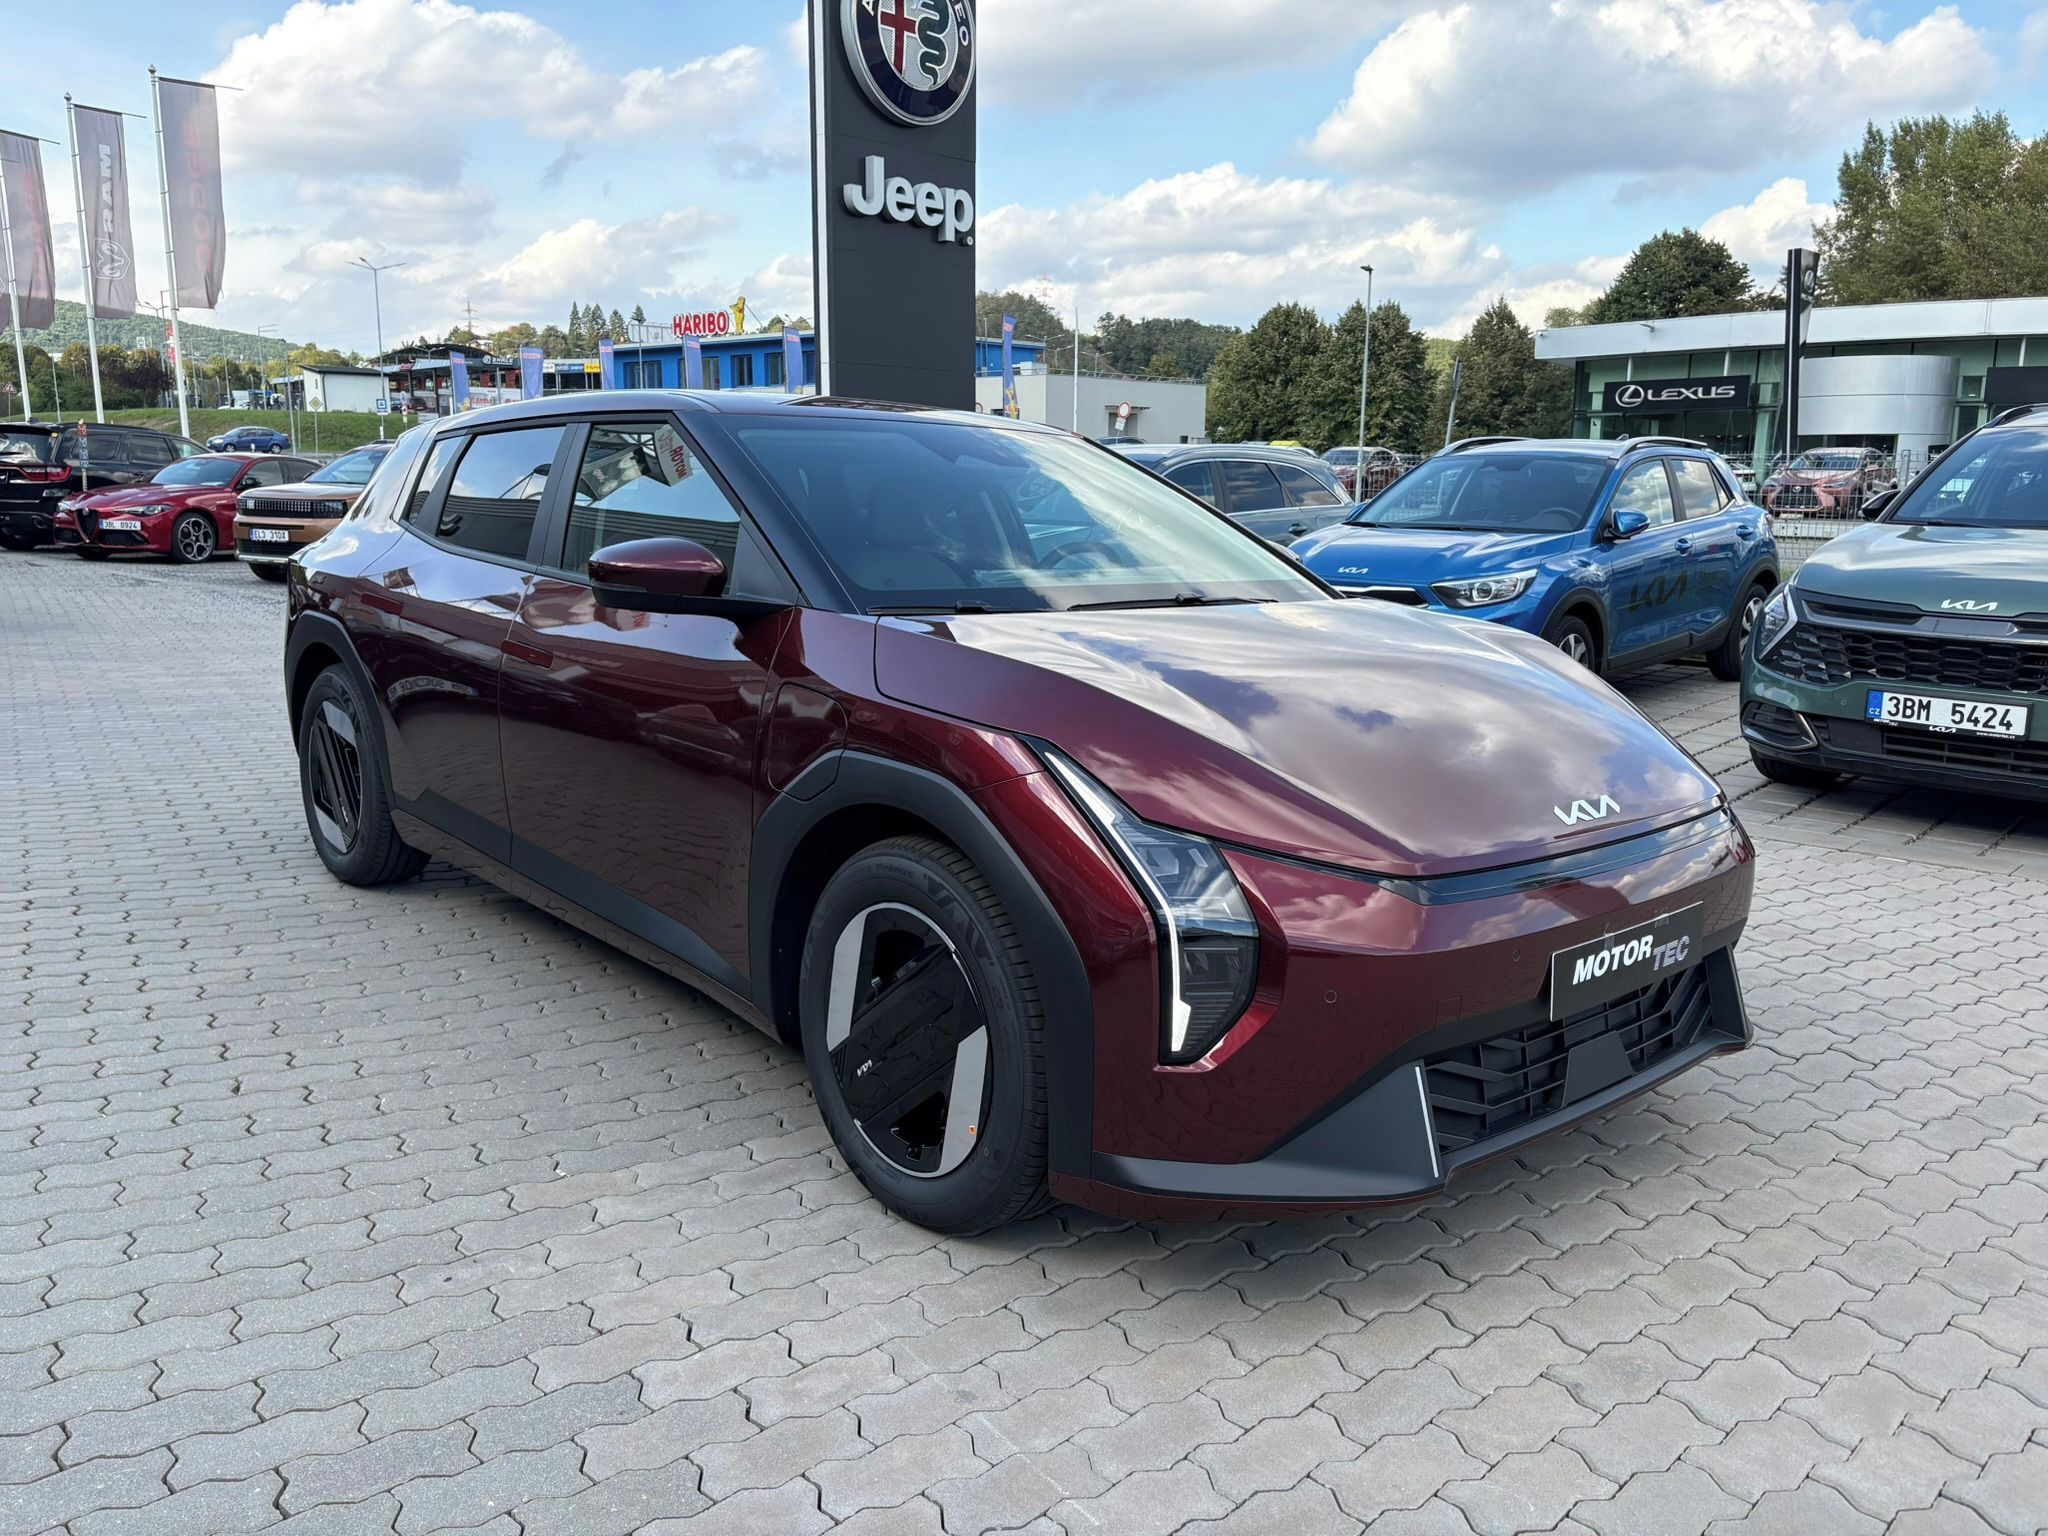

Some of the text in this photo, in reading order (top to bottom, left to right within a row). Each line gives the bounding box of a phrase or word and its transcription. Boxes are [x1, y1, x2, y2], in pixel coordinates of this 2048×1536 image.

[98, 144, 114, 233] RAM
[843, 155, 974, 242] Jeep
[673, 311, 729, 336] HARIBO
[1647, 385, 1735, 401] LEXUS
[1868, 707, 1880, 715] CZ
[1887, 696, 2013, 731] 3BM 5424
[1572, 934, 1654, 985] MOTOR
